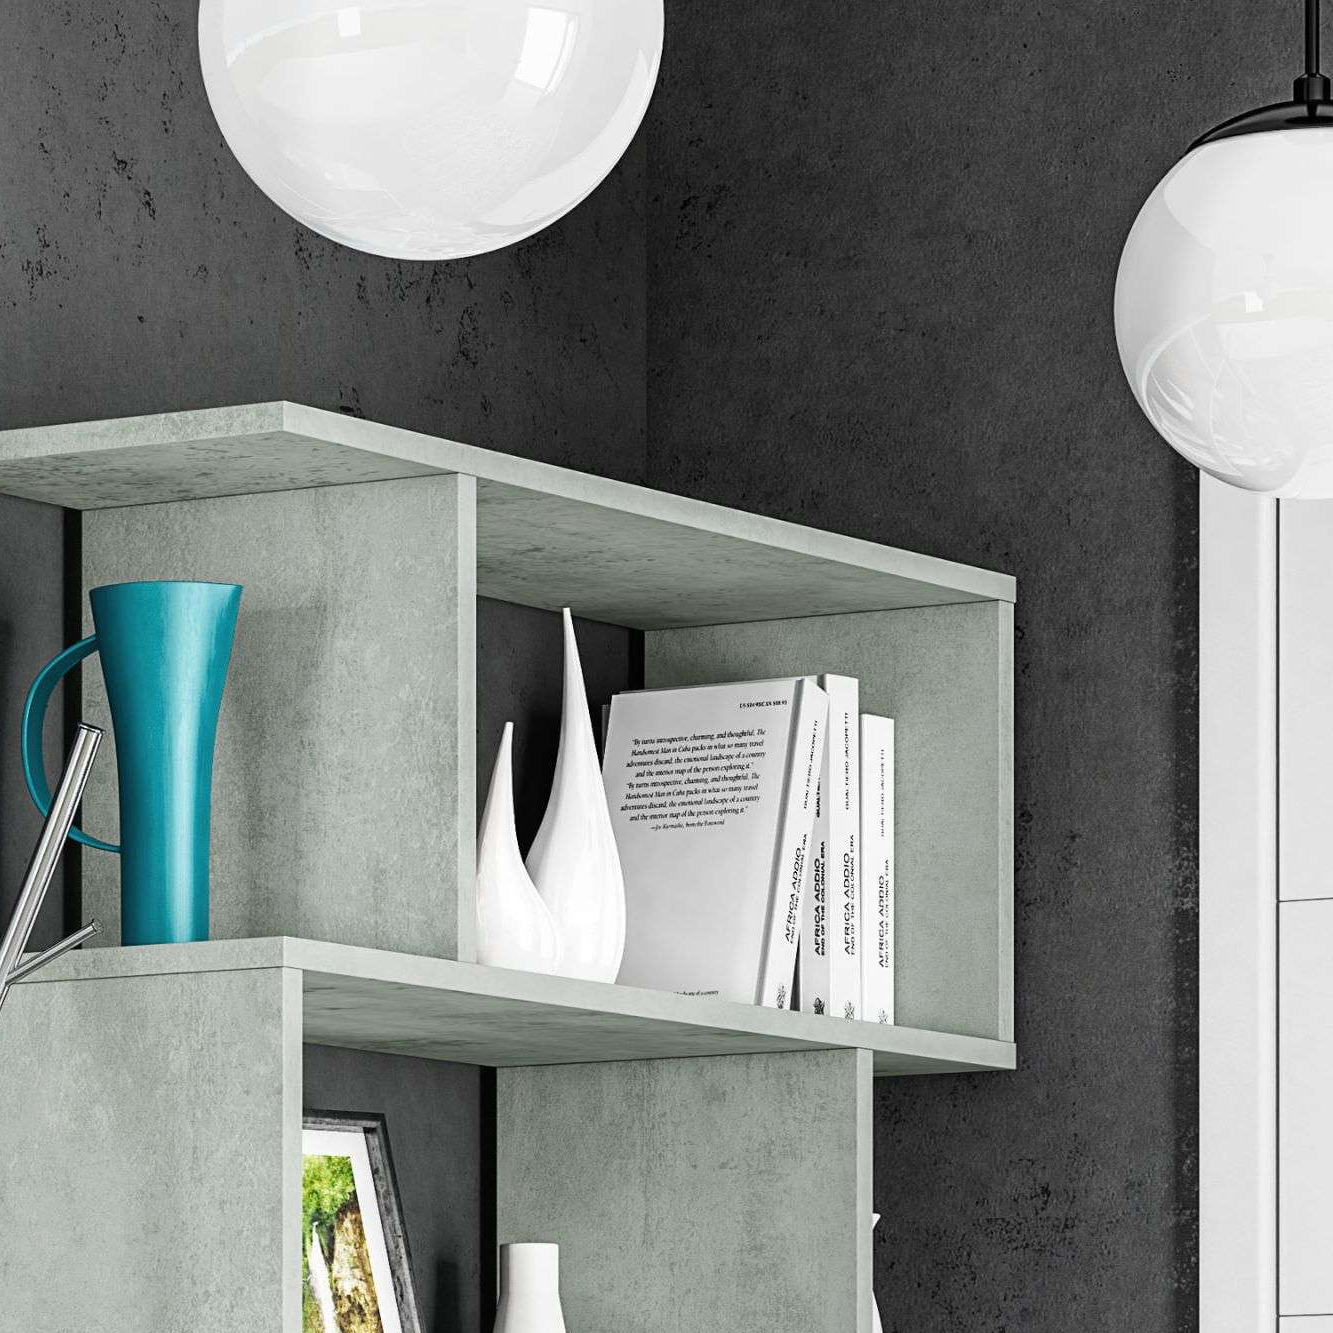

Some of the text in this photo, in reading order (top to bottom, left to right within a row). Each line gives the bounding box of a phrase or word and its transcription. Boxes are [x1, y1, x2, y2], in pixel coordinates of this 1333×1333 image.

[785, 848, 801, 942] AFRICA ADDIO
[821, 924, 825, 936] OF
